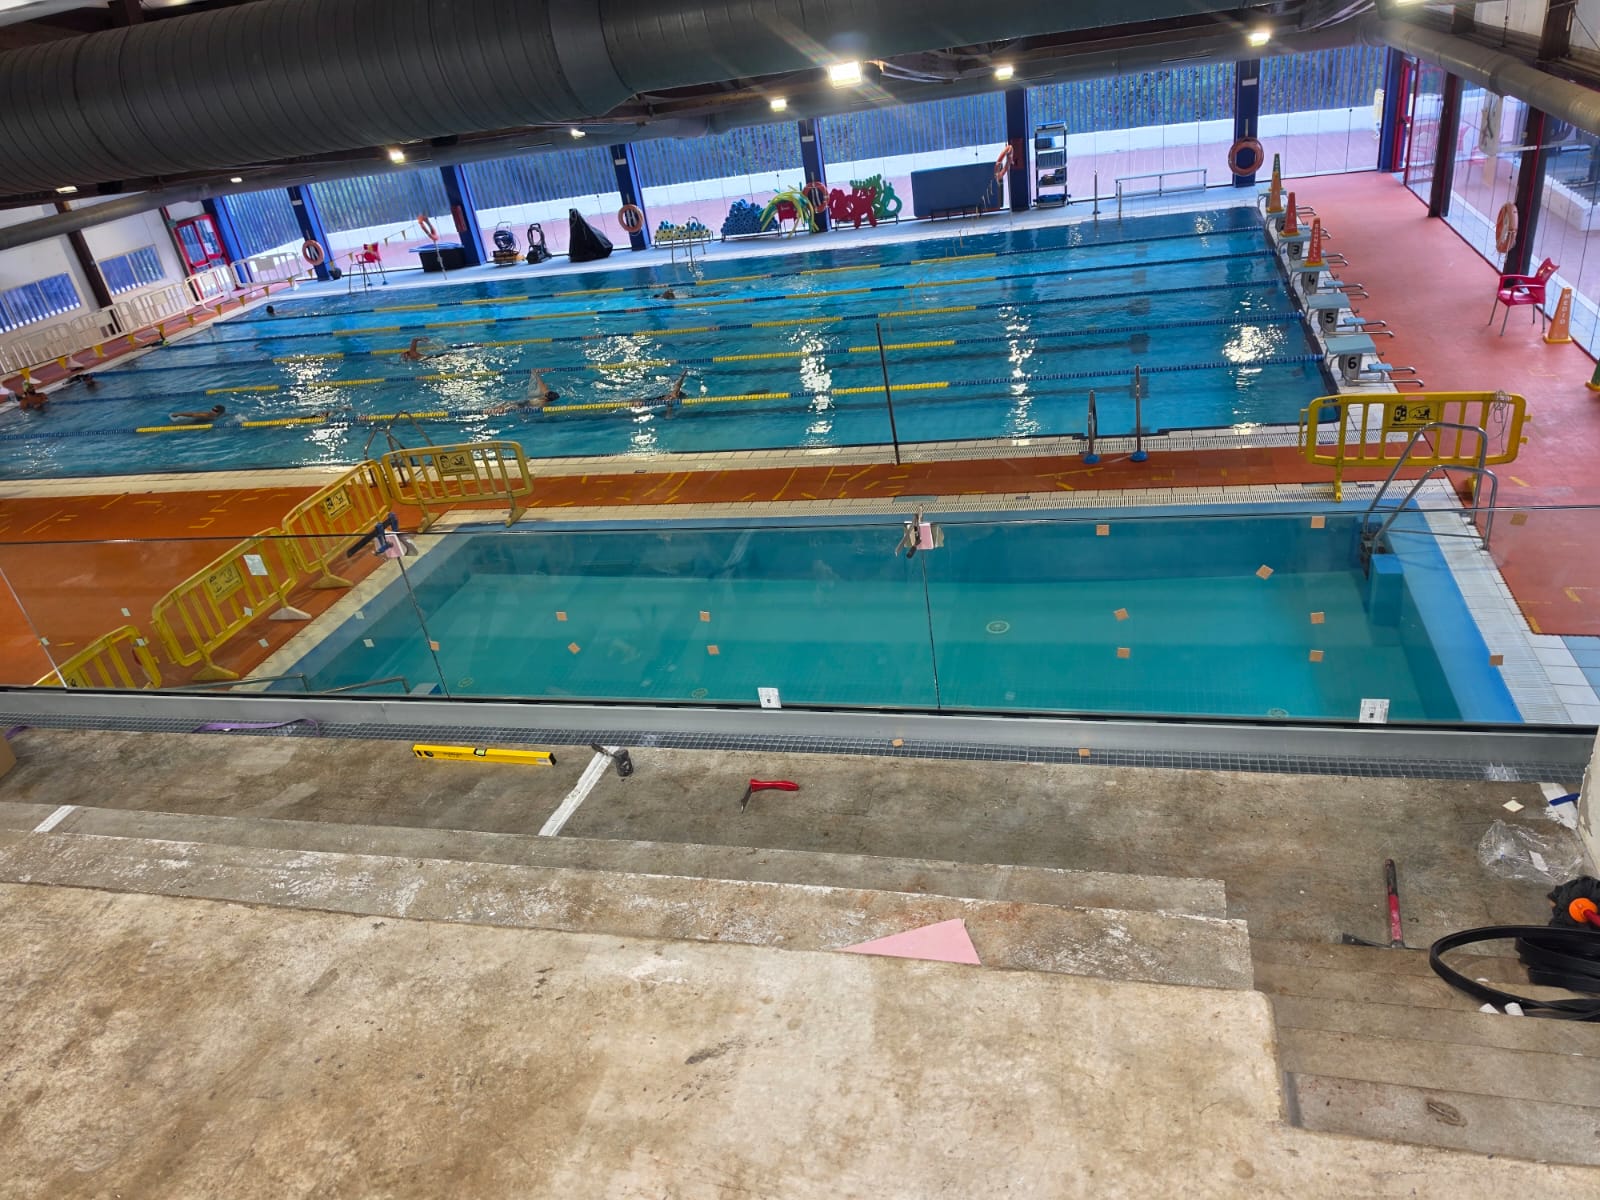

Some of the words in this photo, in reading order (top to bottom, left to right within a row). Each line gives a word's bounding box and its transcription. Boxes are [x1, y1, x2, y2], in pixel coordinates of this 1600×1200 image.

[1292, 244, 1300, 255] 3
[1308, 274, 1315, 285] 4
[1325, 312, 1334, 324] 5
[1347, 356, 1357, 370] 6
